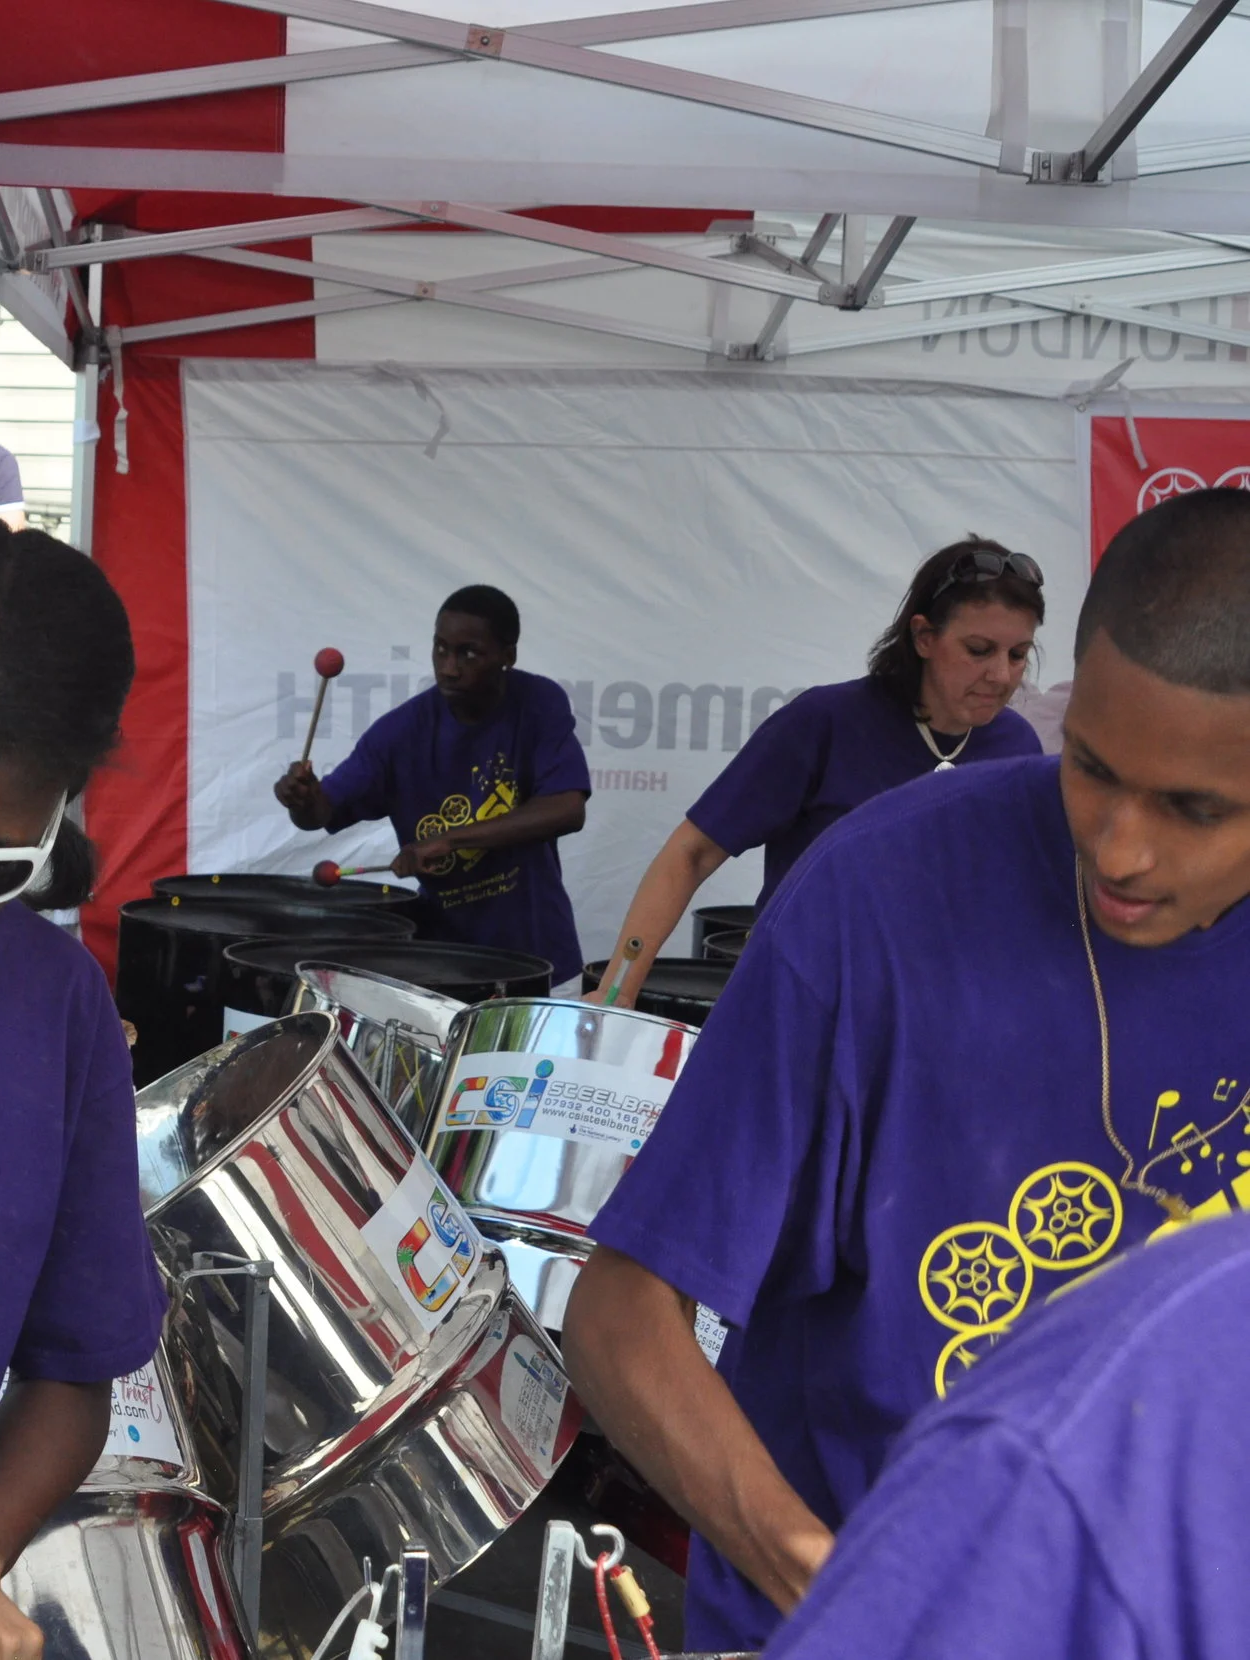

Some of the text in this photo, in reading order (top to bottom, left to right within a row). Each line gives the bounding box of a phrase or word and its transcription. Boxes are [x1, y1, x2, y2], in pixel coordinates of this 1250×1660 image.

[544, 1097, 583, 1112] 07932
[586, 1105, 611, 1118] 400
[542, 1107, 652, 1138] www.csisteelband.co
